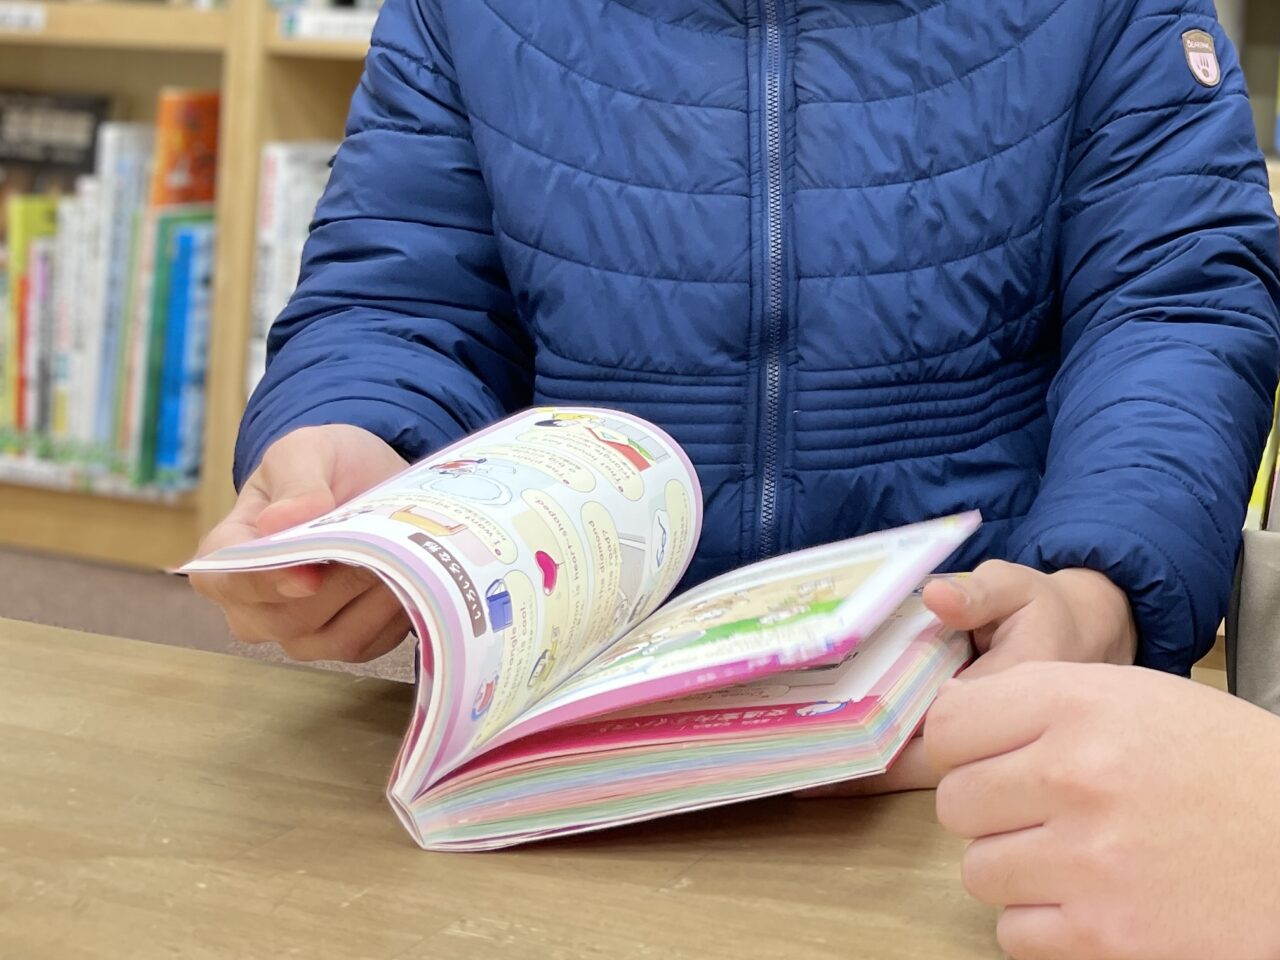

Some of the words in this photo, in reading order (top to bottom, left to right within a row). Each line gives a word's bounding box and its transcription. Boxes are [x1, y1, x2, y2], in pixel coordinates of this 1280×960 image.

[422, 541, 481, 620] いろいろな形
